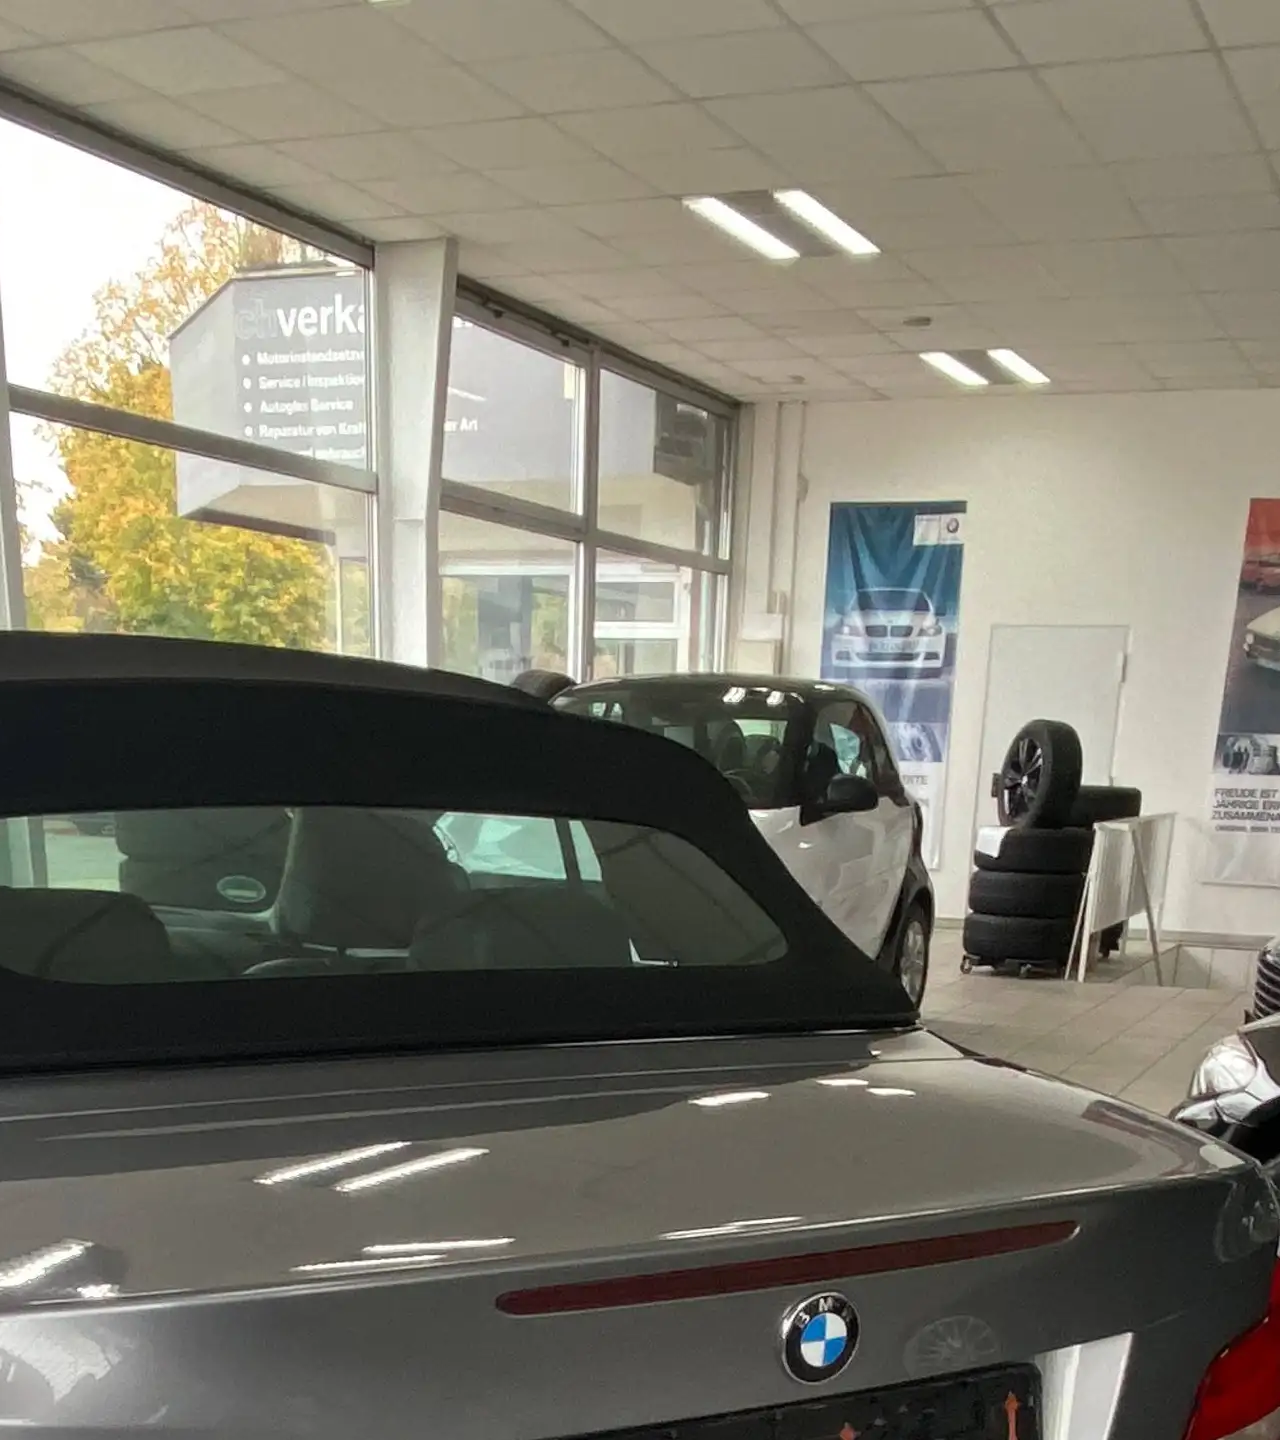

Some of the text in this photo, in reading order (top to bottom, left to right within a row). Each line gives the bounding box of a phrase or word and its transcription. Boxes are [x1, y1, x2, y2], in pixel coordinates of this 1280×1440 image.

[259, 376, 301, 389] Service
[310, 398, 353, 412] Service
[259, 424, 314, 440] Reparatur
[1214, 788, 1258, 798] FREUDE
[1260, 789, 1279, 798] IST
